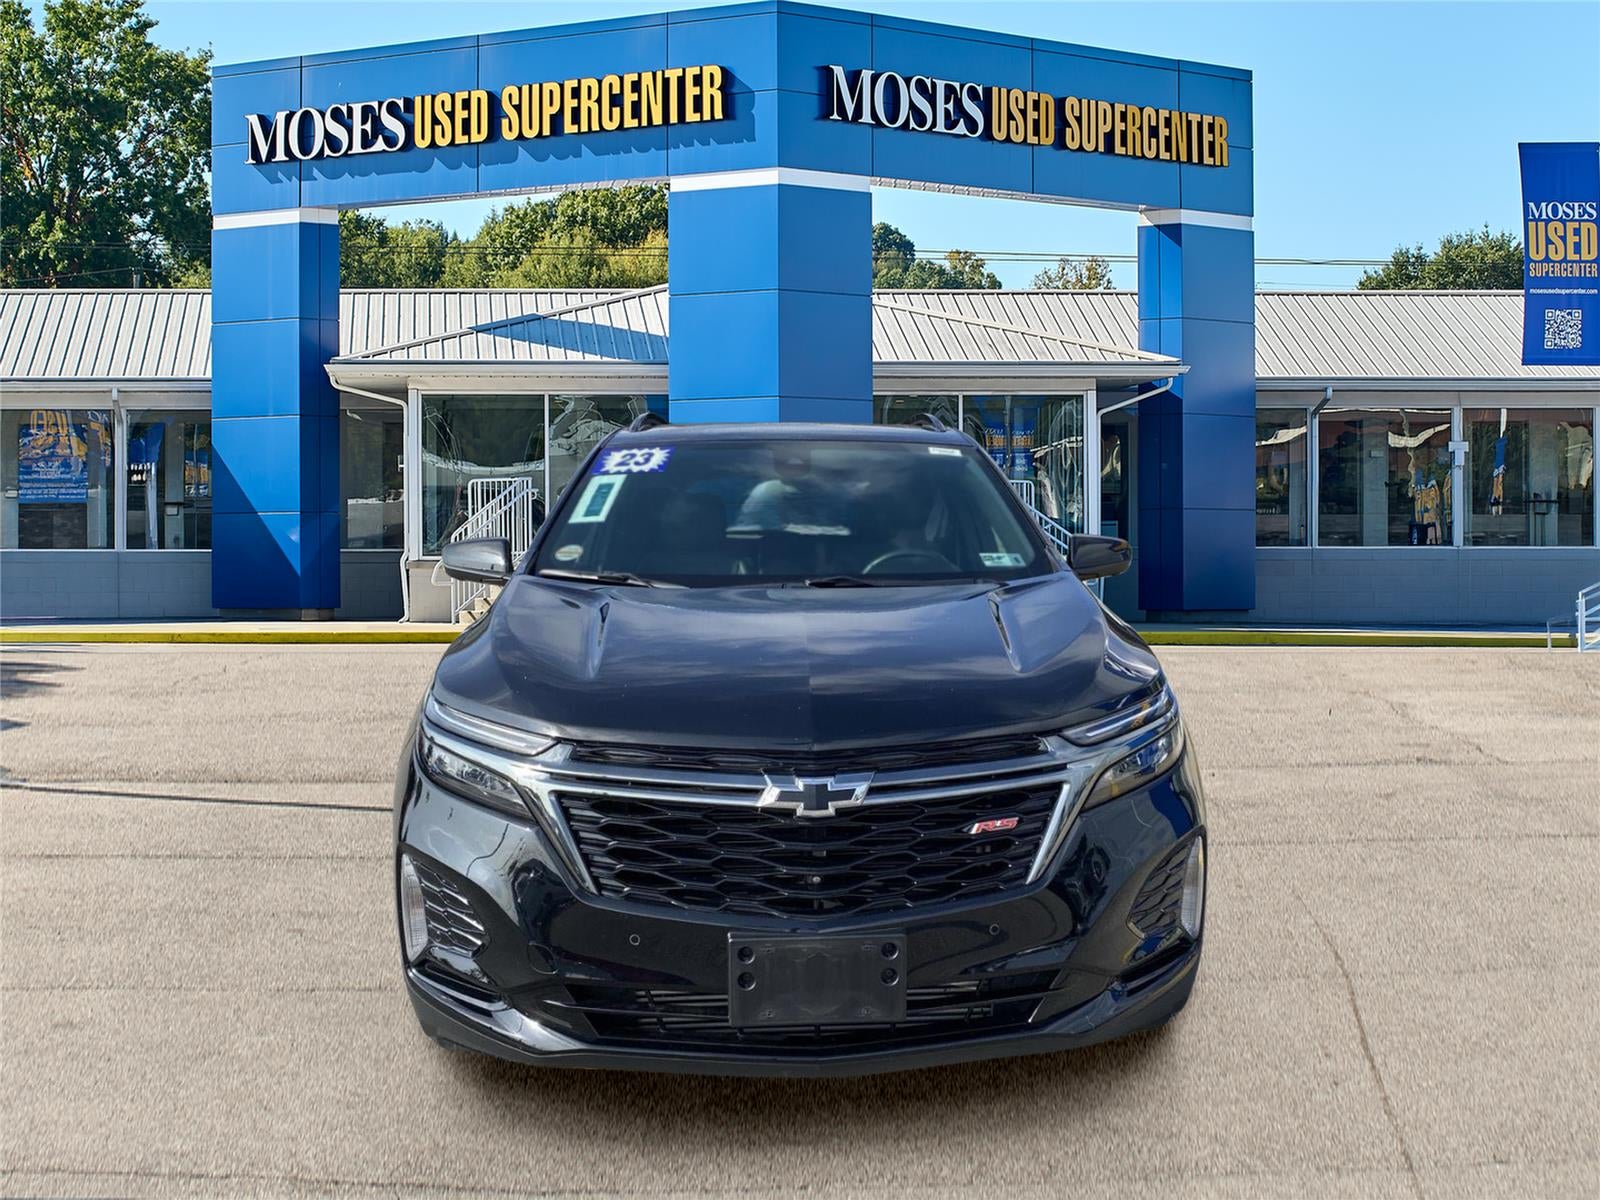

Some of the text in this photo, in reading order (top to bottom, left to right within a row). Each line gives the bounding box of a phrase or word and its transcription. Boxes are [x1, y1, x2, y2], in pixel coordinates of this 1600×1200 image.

[245, 64, 724, 164] MOSES USED SUPERCENTER
[829, 64, 1229, 167] MOSES USED SUPERCENTER
[1528, 202, 1597, 220] MOSES
[1528, 221, 1598, 261] USED
[1529, 263, 1598, 277] SUPERCENTER
[615, 452, 655, 467] 23
[969, 817, 1019, 834] RS
